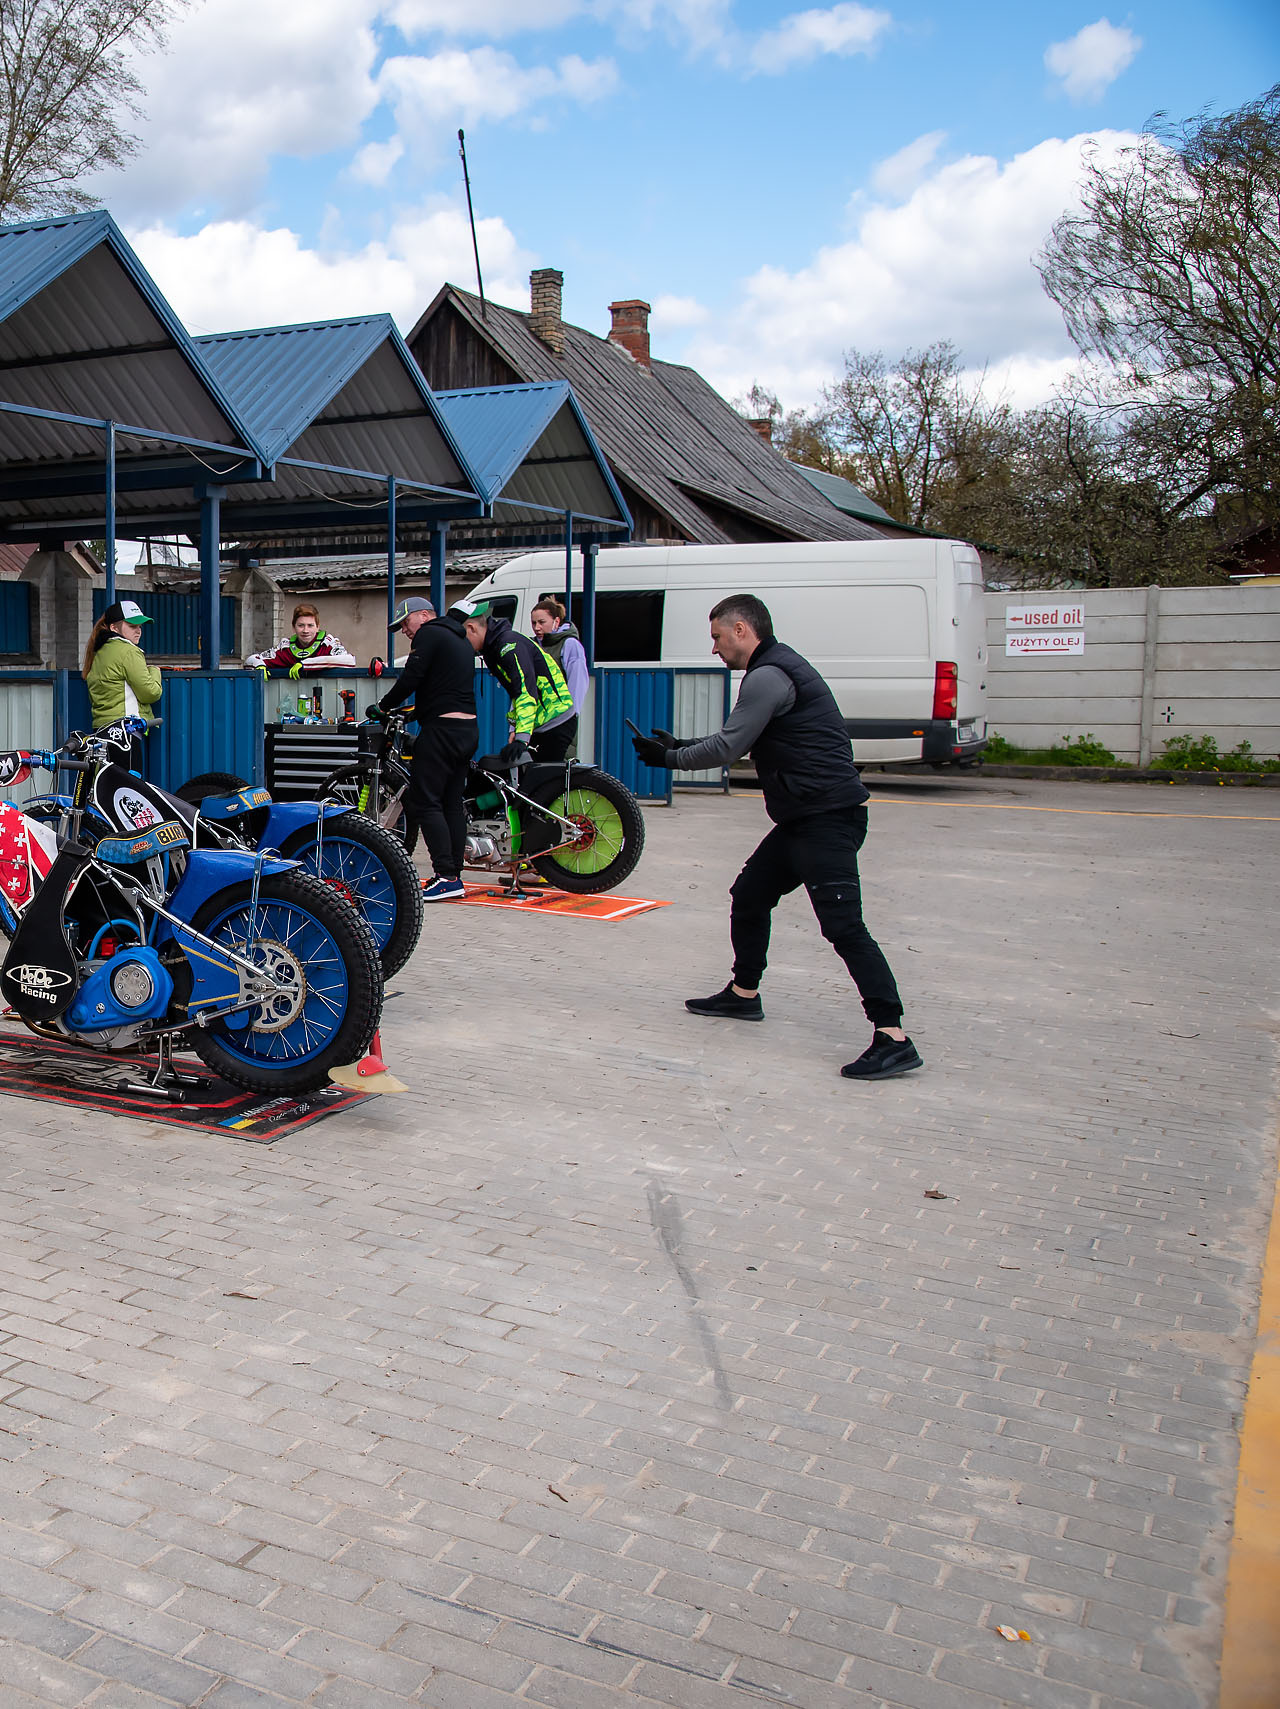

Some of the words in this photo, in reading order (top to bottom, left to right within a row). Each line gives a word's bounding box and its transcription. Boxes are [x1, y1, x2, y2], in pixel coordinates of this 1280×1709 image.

[1024, 609, 1058, 625] used
[1063, 608, 1081, 624] oil
[1010, 637, 1049, 646] ZUŻYTY
[1053, 637, 1080, 646] OLEJ
[20, 983, 58, 1004] Racing
